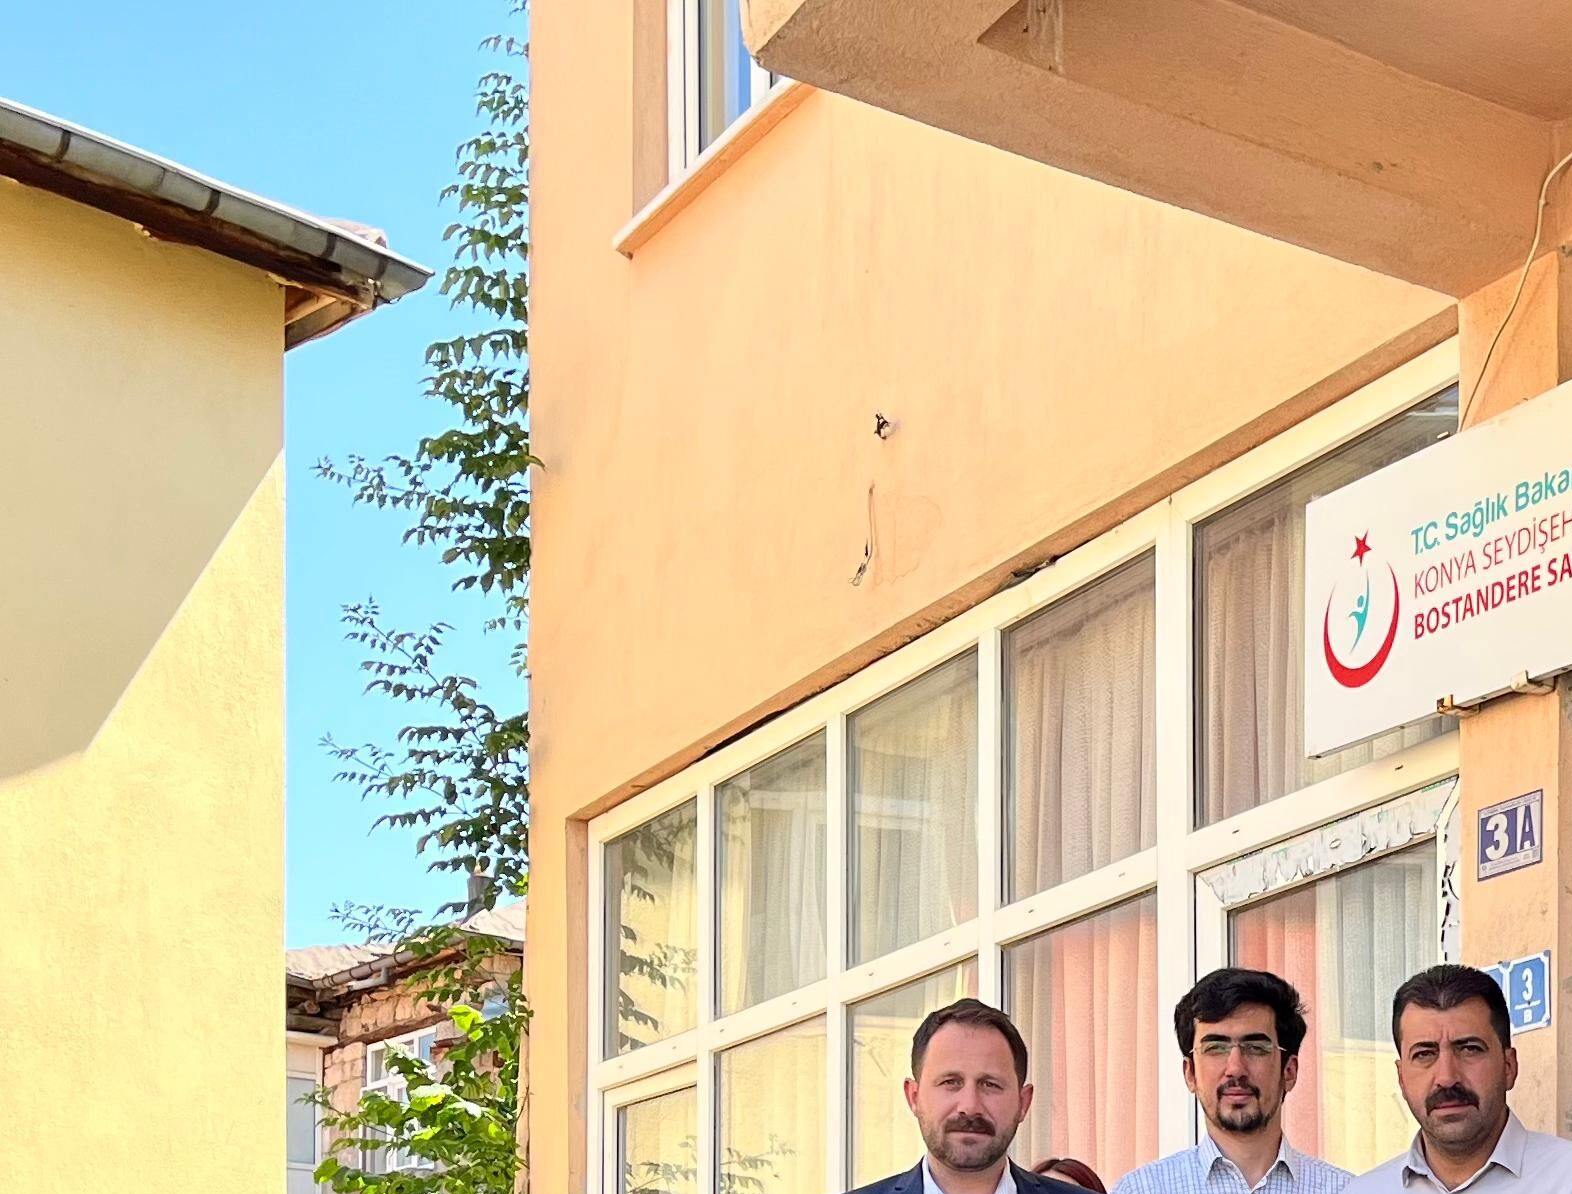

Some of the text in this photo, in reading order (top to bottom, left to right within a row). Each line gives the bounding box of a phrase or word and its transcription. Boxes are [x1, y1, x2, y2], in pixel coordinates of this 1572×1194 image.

[1411, 521, 1440, 555] T.C.
[1445, 492, 1508, 541] Sağlık
[1414, 549, 1477, 599] KONYA
[1414, 565, 1542, 640] BOSTANDERE
[1521, 967, 1534, 1001] 3
